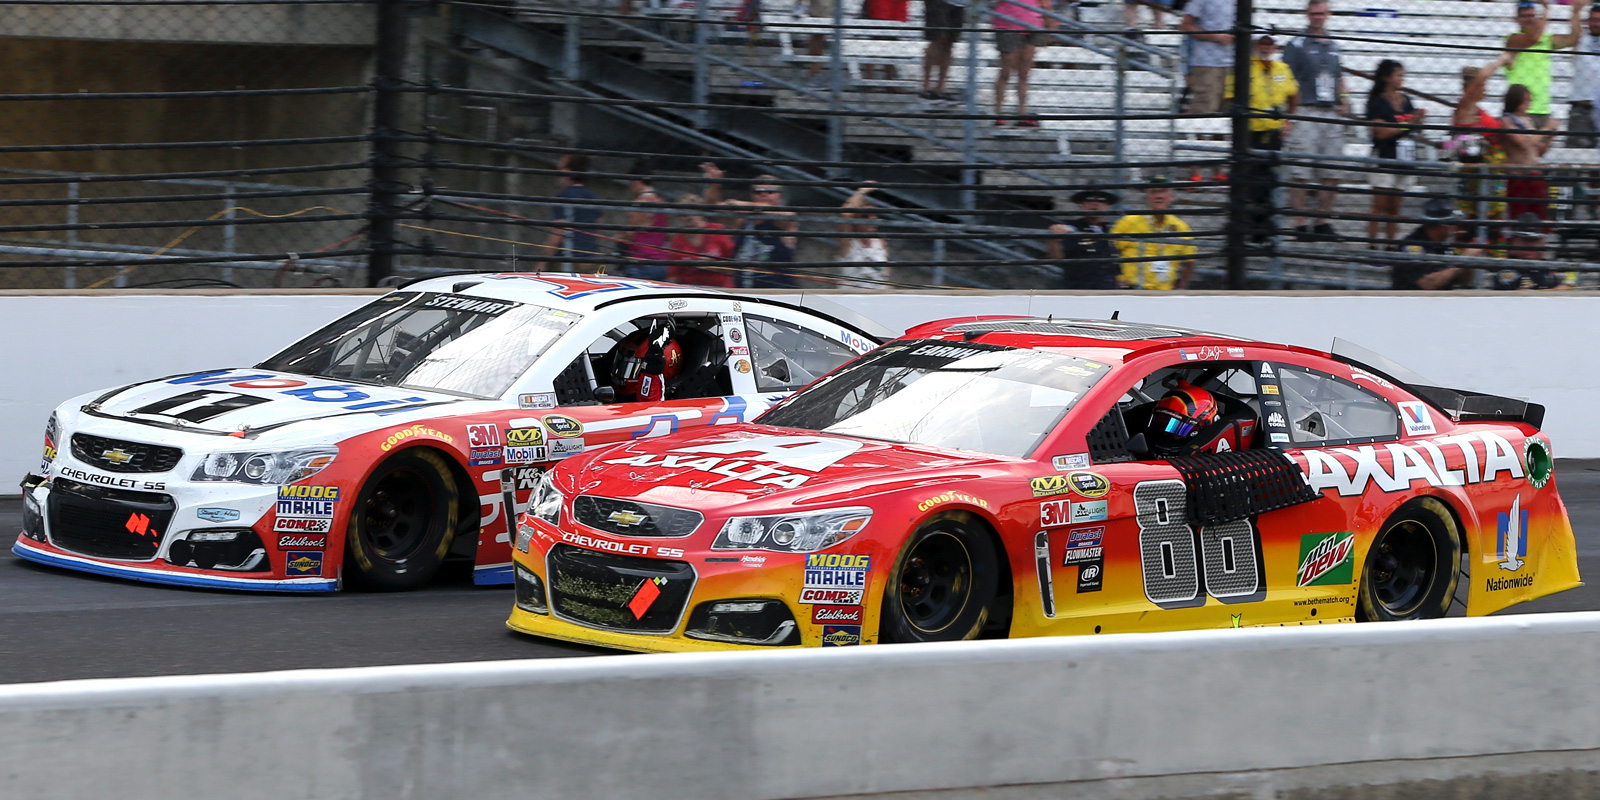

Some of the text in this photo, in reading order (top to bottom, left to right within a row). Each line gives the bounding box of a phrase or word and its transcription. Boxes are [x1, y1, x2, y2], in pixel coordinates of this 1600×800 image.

[424, 295, 514, 314] STEWART
[380, 425, 454, 453] GOODYEAR
[469, 425, 499, 446] 3M
[470, 448, 501, 460] Duralast
[507, 447, 534, 460] Mobil
[1523, 436, 1550, 458] AMERICAN
[1300, 431, 1525, 497] AXALTA
[60, 466, 140, 488] CHEVROLET
[143, 481, 166, 491] SS
[517, 467, 545, 480] K&
[601, 454, 812, 490] AXALTA
[1527, 467, 1552, 489] ETHANOL
[278, 485, 339, 498] MOOG
[1081, 481, 1097, 489] Sprint
[276, 501, 333, 515] MAHLE
[917, 490, 989, 512] GOODYEAR
[1041, 501, 1070, 526] 3M
[277, 519, 317, 529] COMP
[278, 535, 325, 547] Edelbrock
[1070, 528, 1103, 541] Duralast
[562, 532, 685, 558] CHEVROLET SS
[807, 554, 870, 568] MOOG
[1064, 547, 1103, 565] FLOWMASTER
[805, 571, 865, 586] MAHLE
[1084, 568, 1097, 579] IR
[1486, 574, 1534, 592] Nationwide
[803, 590, 848, 601] COMP
[1293, 596, 1350, 606] www.bethematch.org
[815, 609, 859, 621] Edelbrock
[824, 635, 858, 643] SUNOCO
